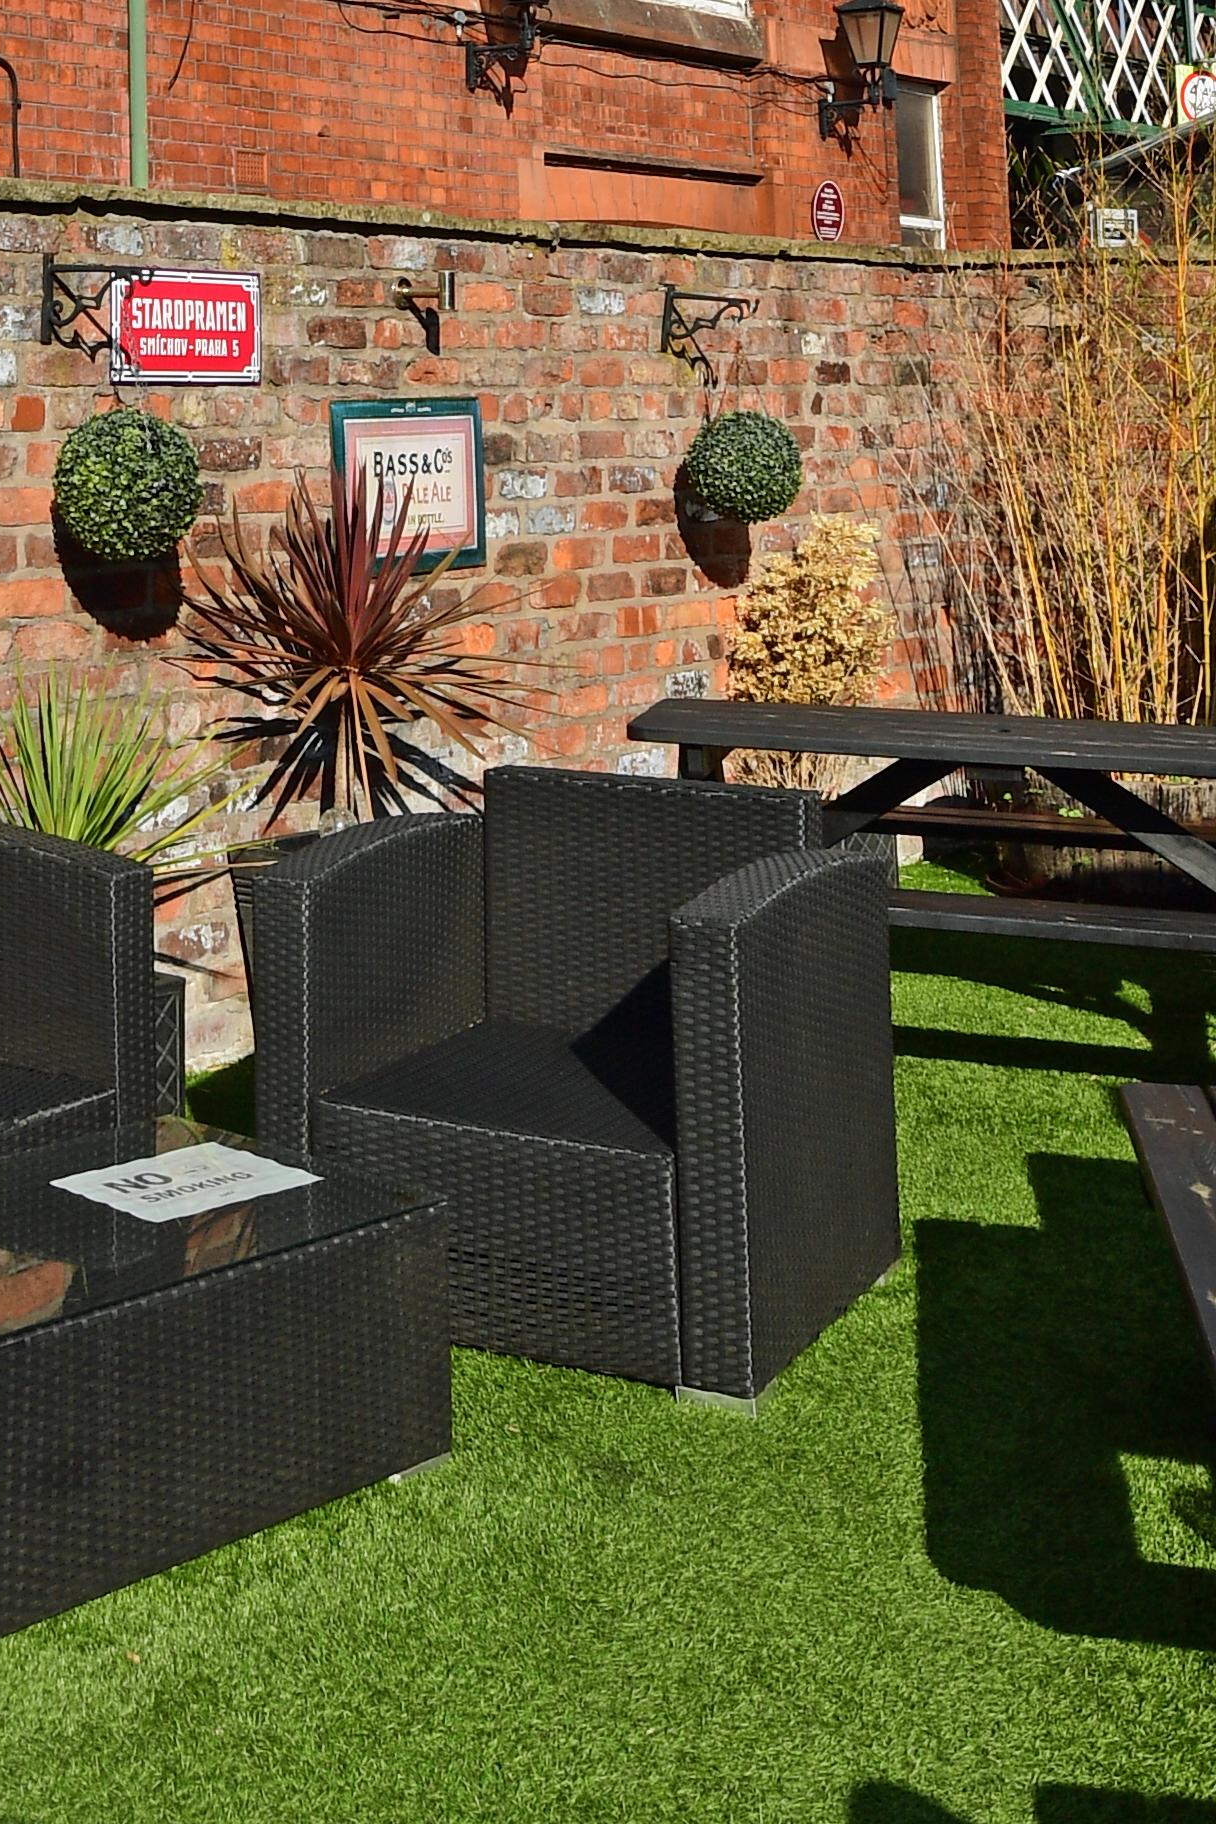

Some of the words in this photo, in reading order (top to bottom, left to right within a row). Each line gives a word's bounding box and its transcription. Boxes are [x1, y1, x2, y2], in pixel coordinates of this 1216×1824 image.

[131, 297, 247, 332] STAROPRAMEN
[232, 339, 239, 357] 5
[373, 451, 419, 478] BASS
[421, 453, 432, 475] &
[431, 481, 452, 504] ALE
[101, 1172, 173, 1194] NO
[140, 1171, 254, 1204] SMOKING
